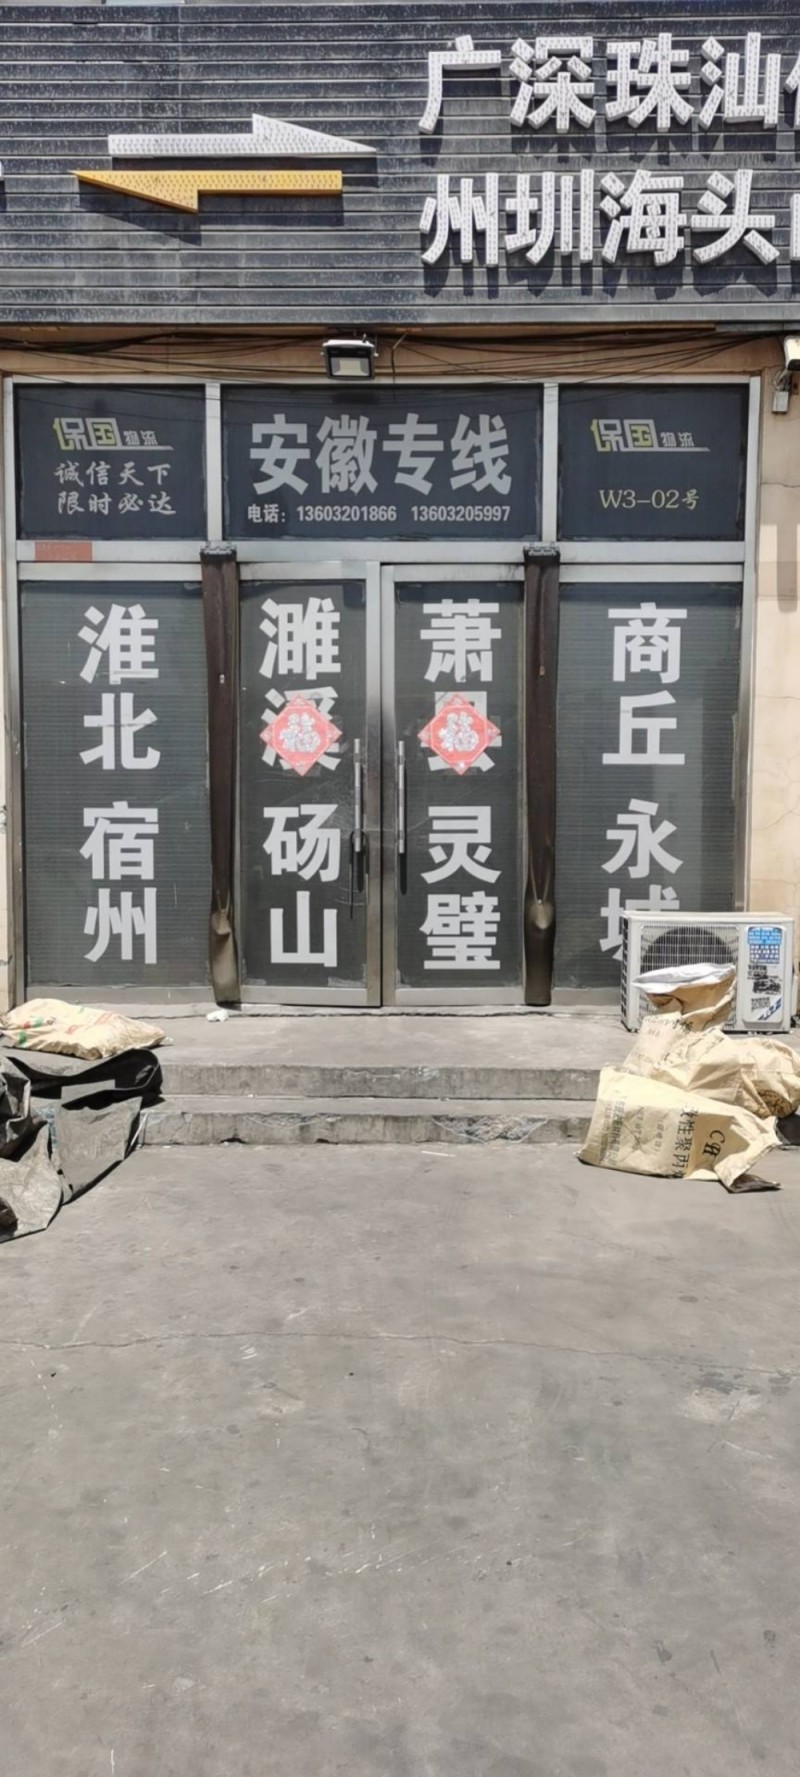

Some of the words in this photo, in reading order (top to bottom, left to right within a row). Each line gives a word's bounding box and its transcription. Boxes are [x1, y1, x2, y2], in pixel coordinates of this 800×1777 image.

[54, 460, 172, 487] 诚信天下
[57, 490, 177, 516] 限时必达
[249, 412, 512, 496] 安徽专线
[296, 505, 397, 523] 13603201866
[411, 505, 511, 523] 13603205997
[78, 603, 161, 771] 淮北
[602, 602, 688, 766] 商丘
[80, 801, 160, 966] 宿州
[262, 804, 342, 969] 砀山
[420, 805, 502, 972] 灵璧
